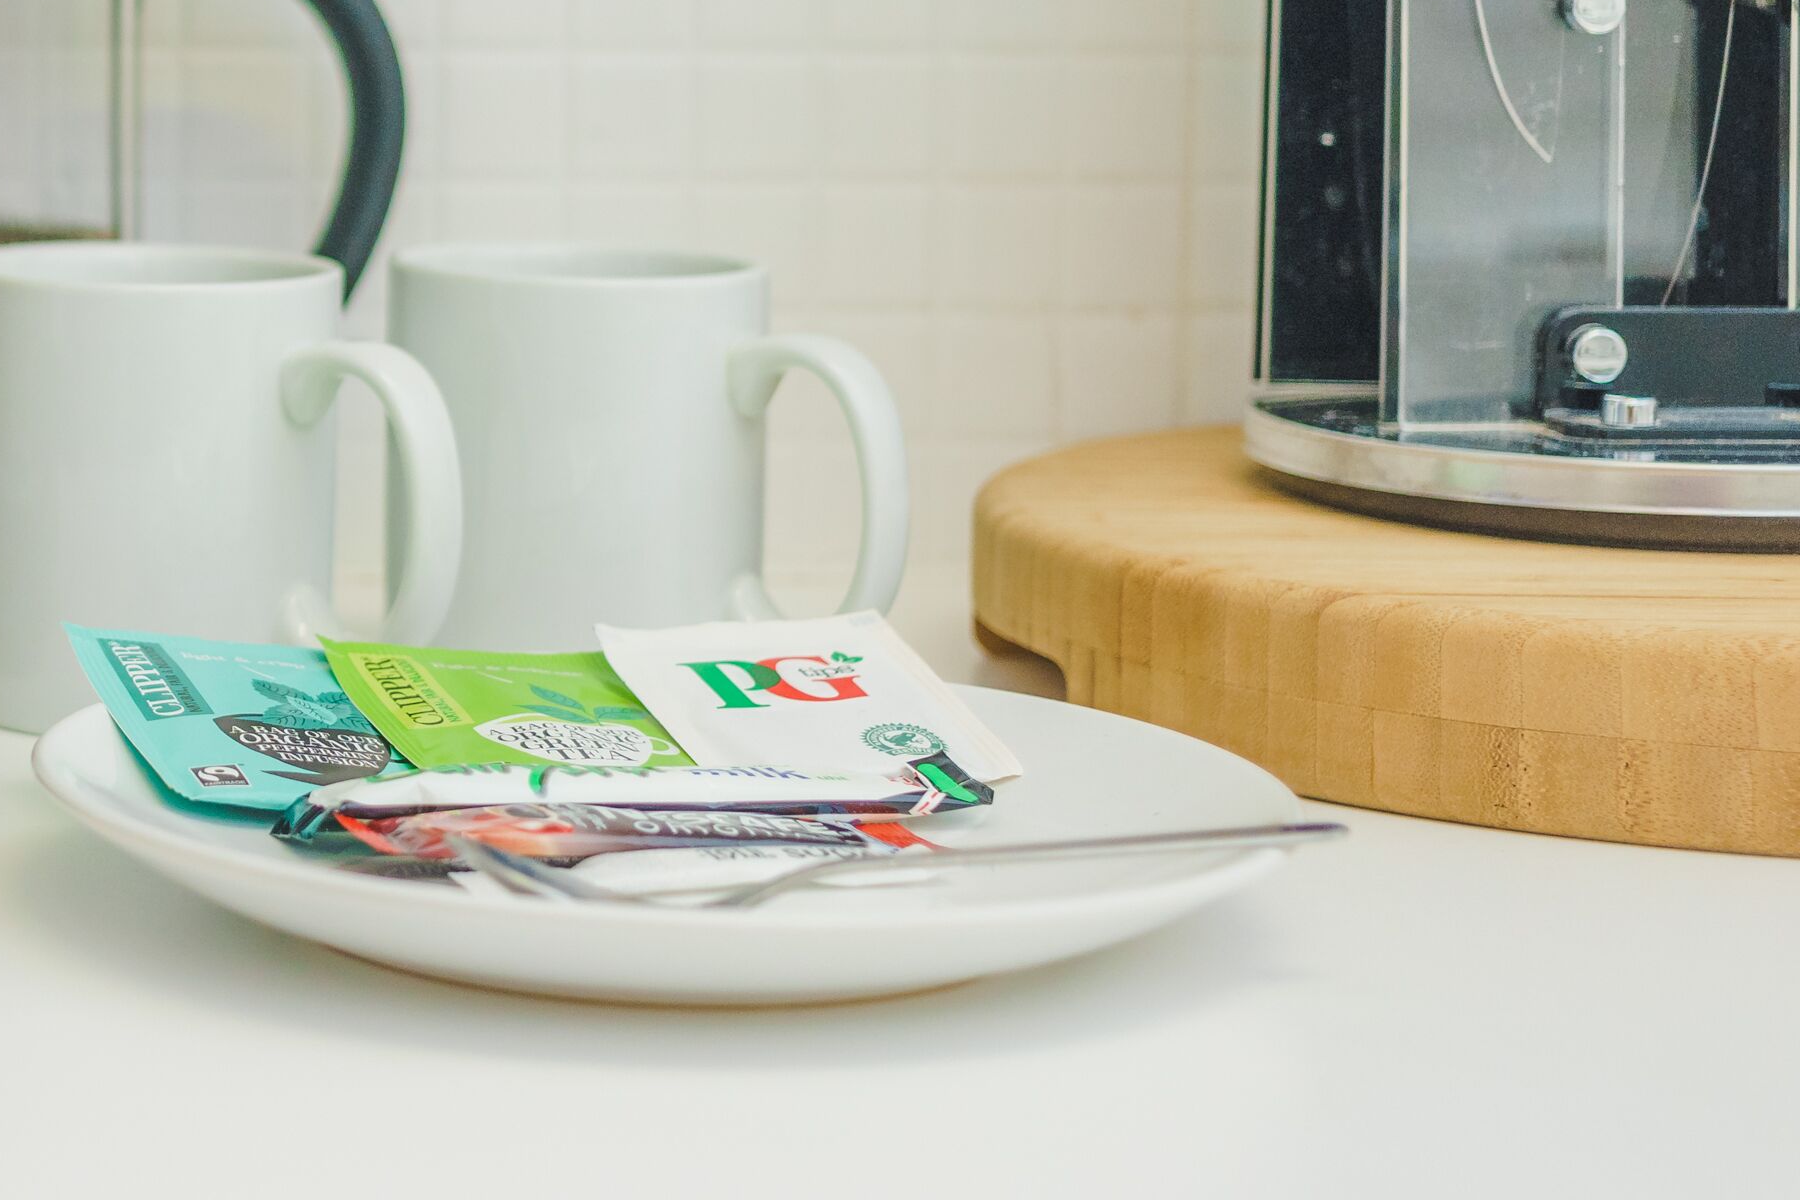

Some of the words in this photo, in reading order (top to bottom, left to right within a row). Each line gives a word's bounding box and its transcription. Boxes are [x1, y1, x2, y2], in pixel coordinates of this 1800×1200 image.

[112, 644, 185, 716] CLIPPER
[675, 655, 869, 709] PG
[363, 658, 444, 726] CLIPPER
[229, 725, 247, 734] A
[251, 725, 300, 737] BAG
[304, 729, 331, 739] OF
[337, 734, 385, 746] OUR
[489, 728, 503, 736] A
[510, 722, 557, 733] BAG
[497, 729, 647, 744] ORGANIC
[238, 733, 386, 754] ORGANIC
[257, 743, 385, 762] PEPPERMINT
[520, 738, 641, 753] GREEN
[278, 752, 380, 769] INFUSION
[546, 748, 638, 761] TEA
[681, 766, 811, 780] milk
